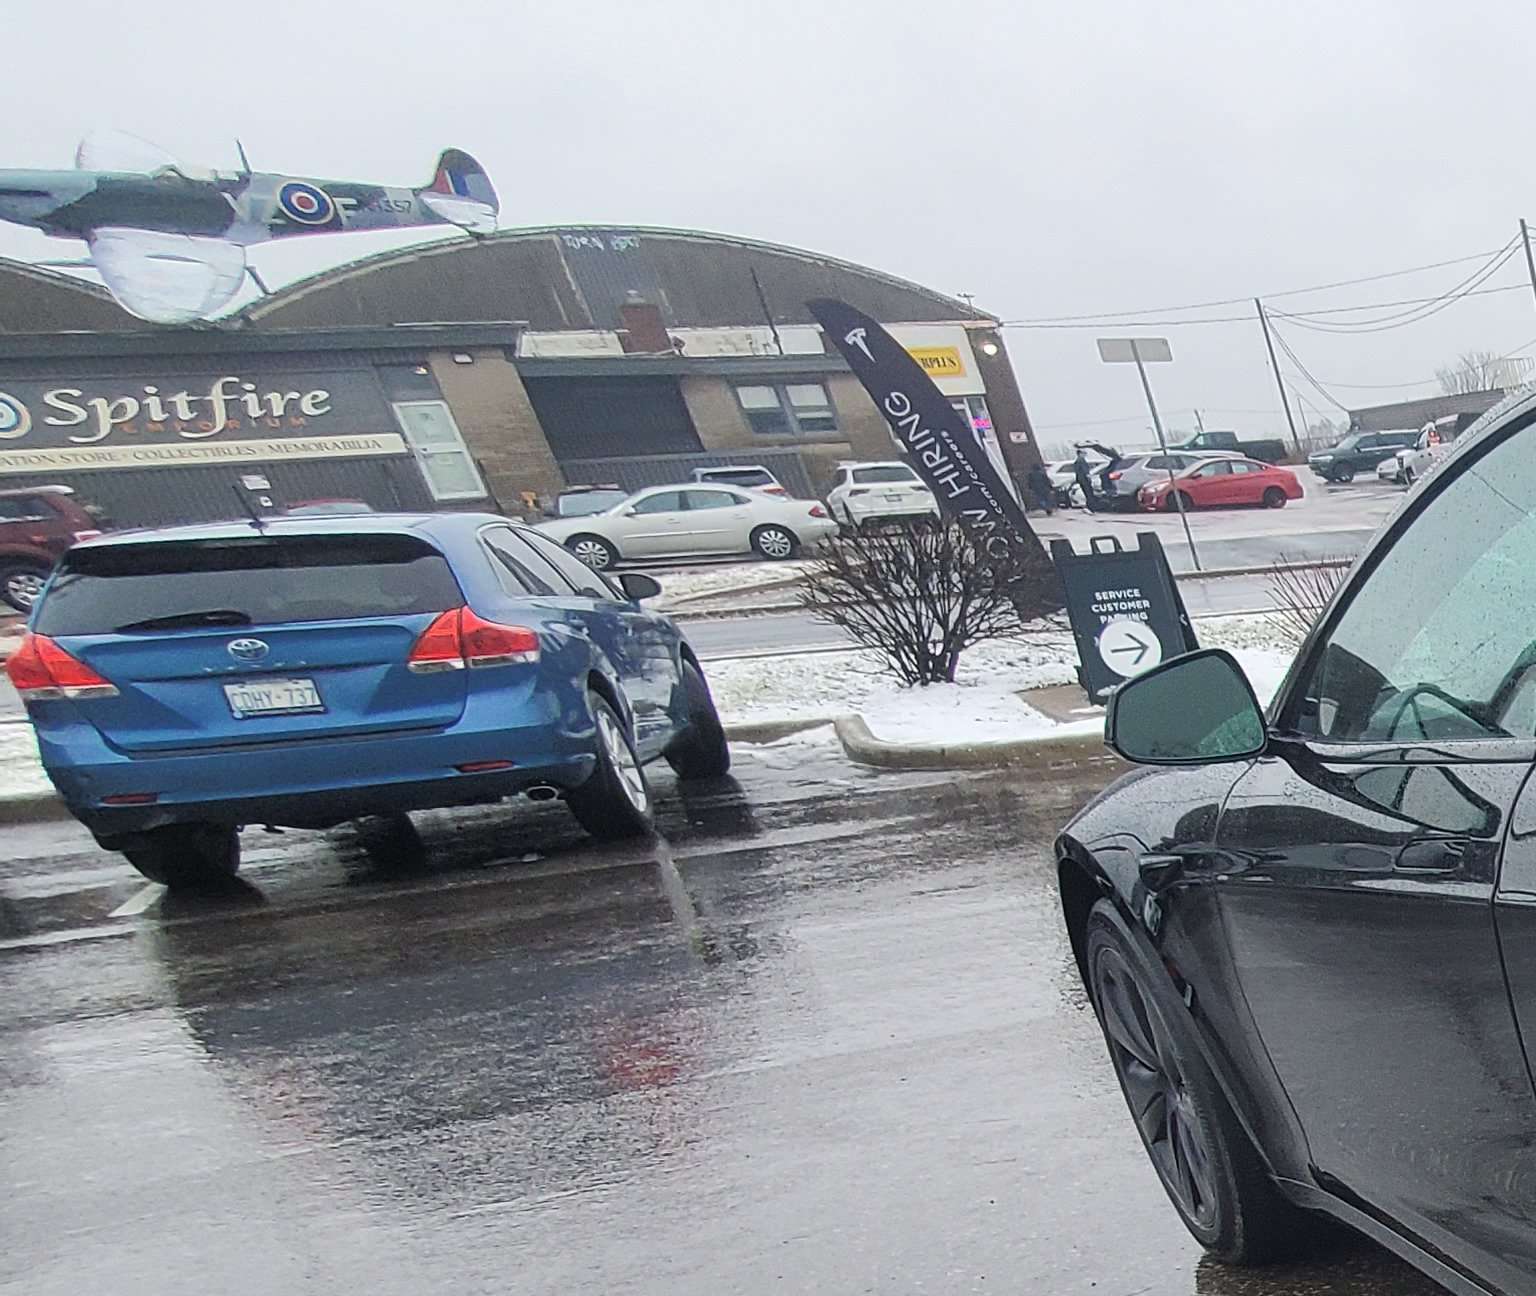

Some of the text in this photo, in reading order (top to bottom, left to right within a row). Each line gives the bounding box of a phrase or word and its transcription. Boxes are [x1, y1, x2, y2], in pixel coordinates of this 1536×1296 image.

[43, 377, 332, 444] Spitfire
[59, 451, 120, 464] STORE
[132, 446, 257, 461] COLLECTIBLES
[267, 439, 383, 455] MEMORABILIA
[884, 391, 970, 499] HIRING
[1091, 600, 1151, 613] CUSTOMER
[1095, 589, 1141, 601] SERVICE
